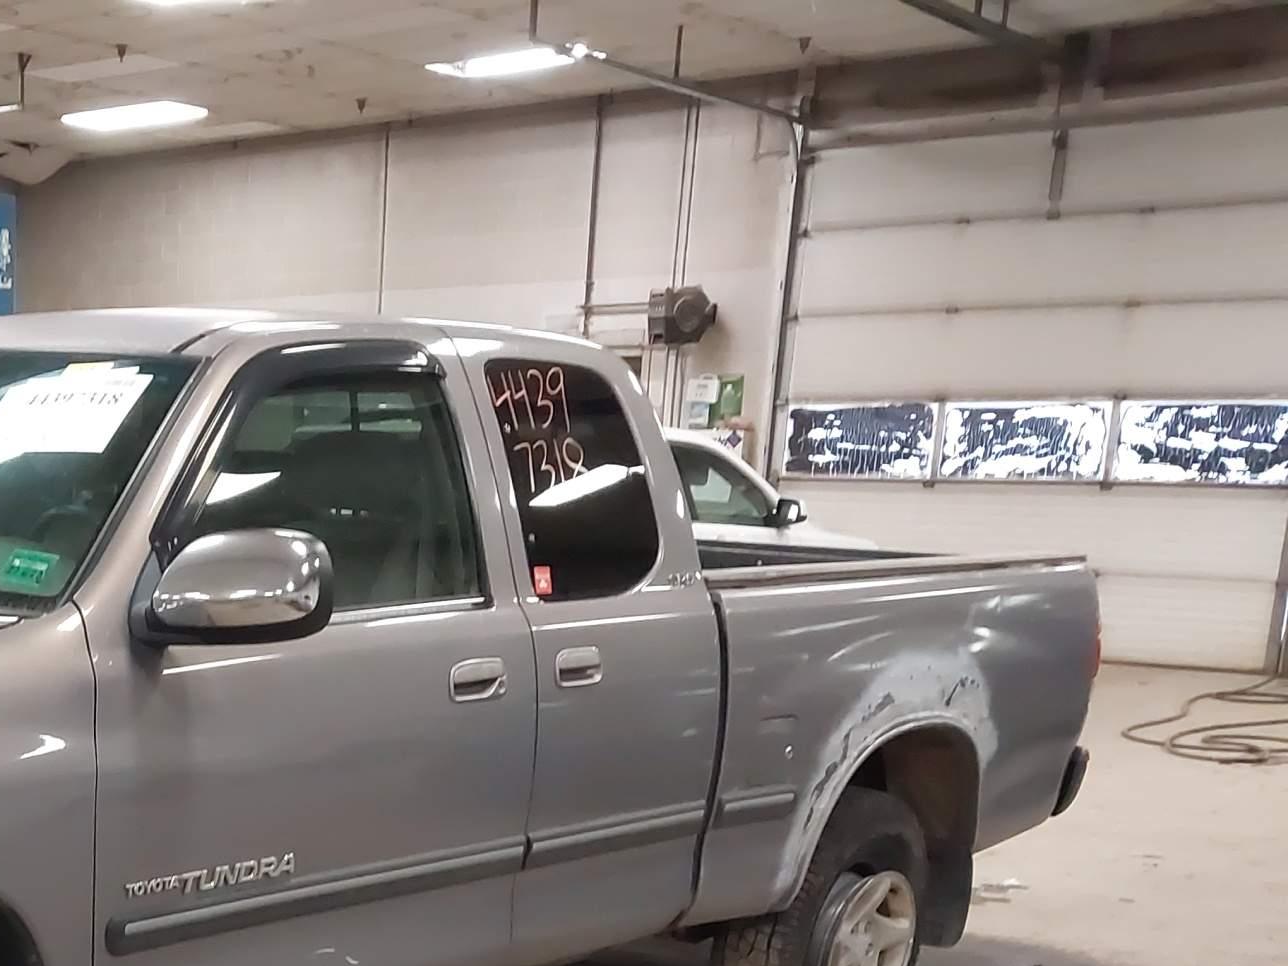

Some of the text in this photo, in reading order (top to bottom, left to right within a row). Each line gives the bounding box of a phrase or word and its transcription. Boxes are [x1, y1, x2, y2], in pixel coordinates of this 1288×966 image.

[487, 367, 570, 433] 4439
[125, 852, 295, 899] TOYOTA TUNDRA
